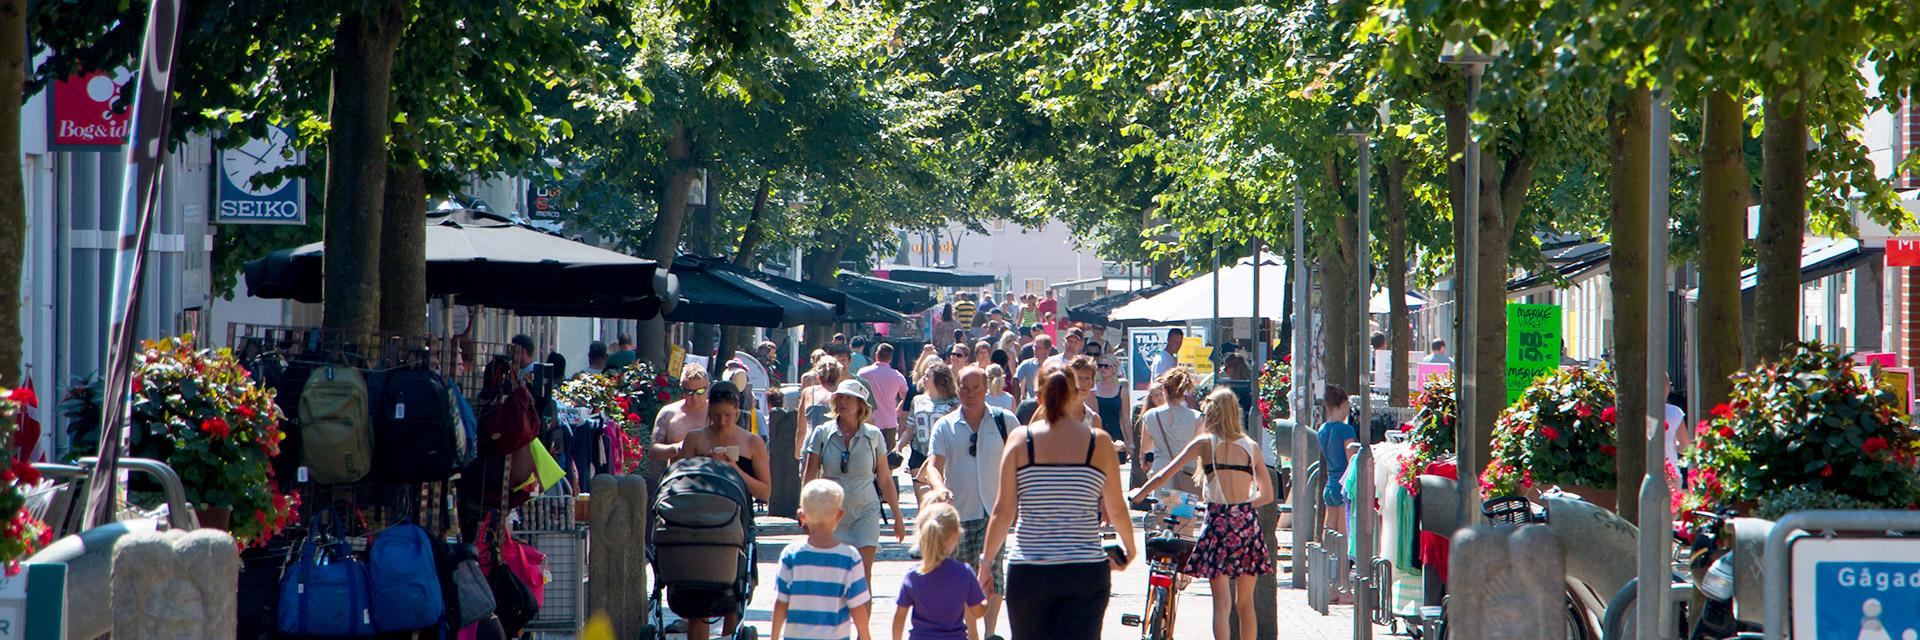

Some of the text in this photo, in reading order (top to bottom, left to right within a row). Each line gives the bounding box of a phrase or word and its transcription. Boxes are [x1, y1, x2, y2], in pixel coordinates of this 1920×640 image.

[58, 120, 131, 140] Bog&id
[221, 200, 297, 218] SEIKO
[1898, 240, 1920, 250] M
